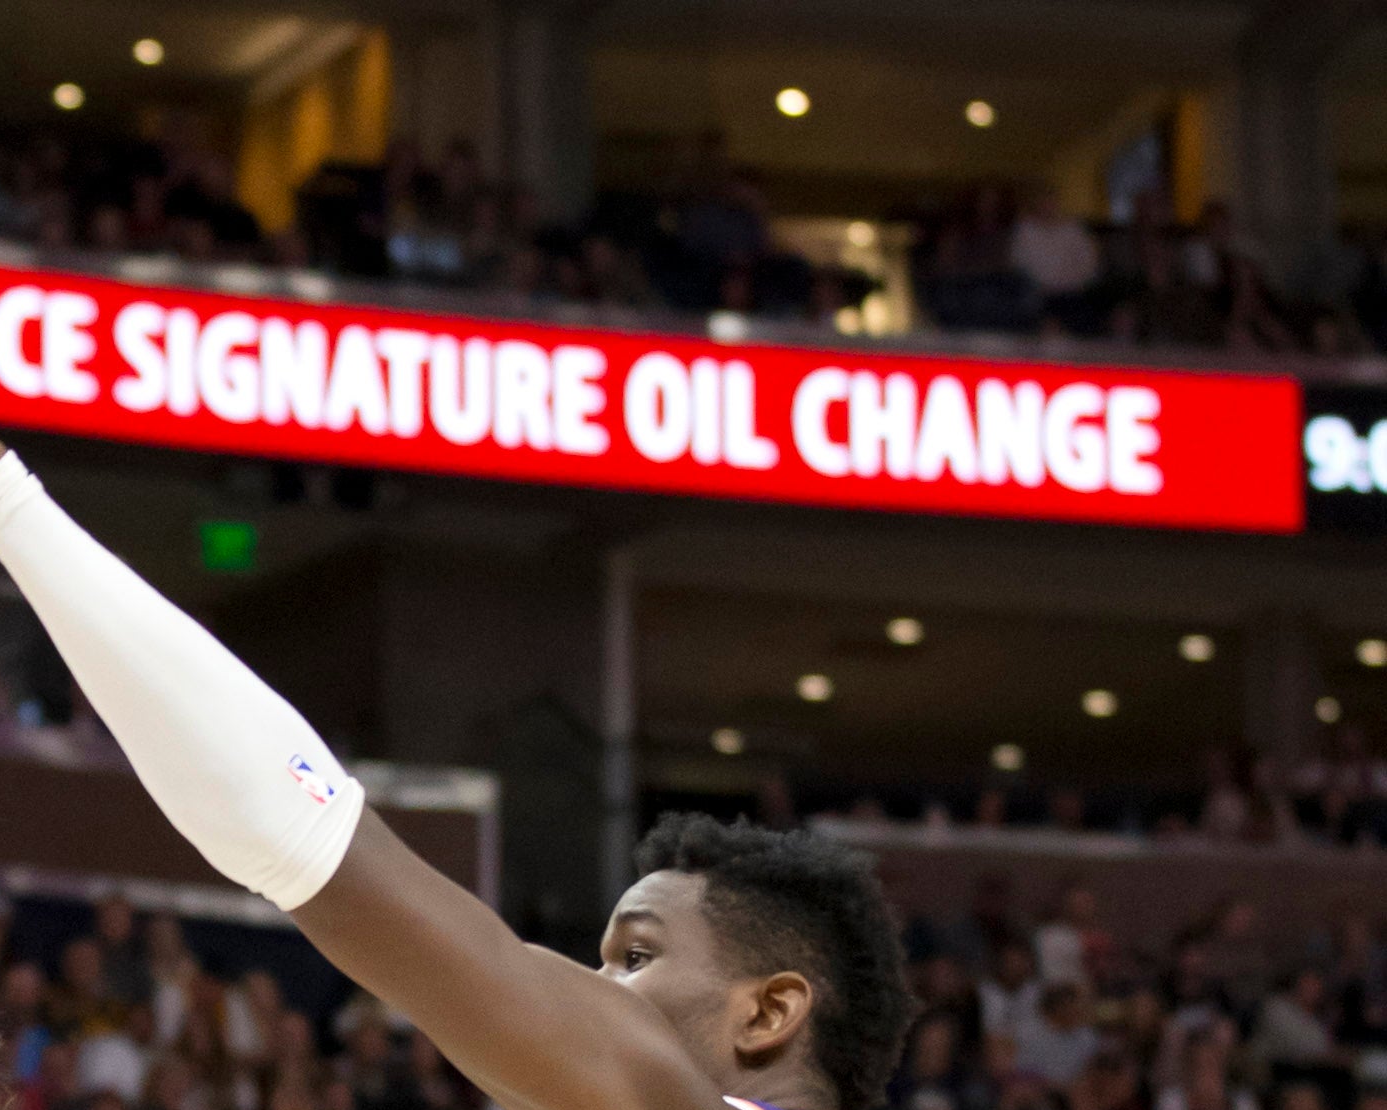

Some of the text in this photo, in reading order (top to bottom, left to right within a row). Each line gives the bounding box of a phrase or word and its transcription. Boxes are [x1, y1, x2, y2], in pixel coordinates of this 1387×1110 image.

[114, 303, 608, 454] SIGNATURE
[624, 353, 778, 468] OIL
[792, 368, 1161, 494] CHANGE
